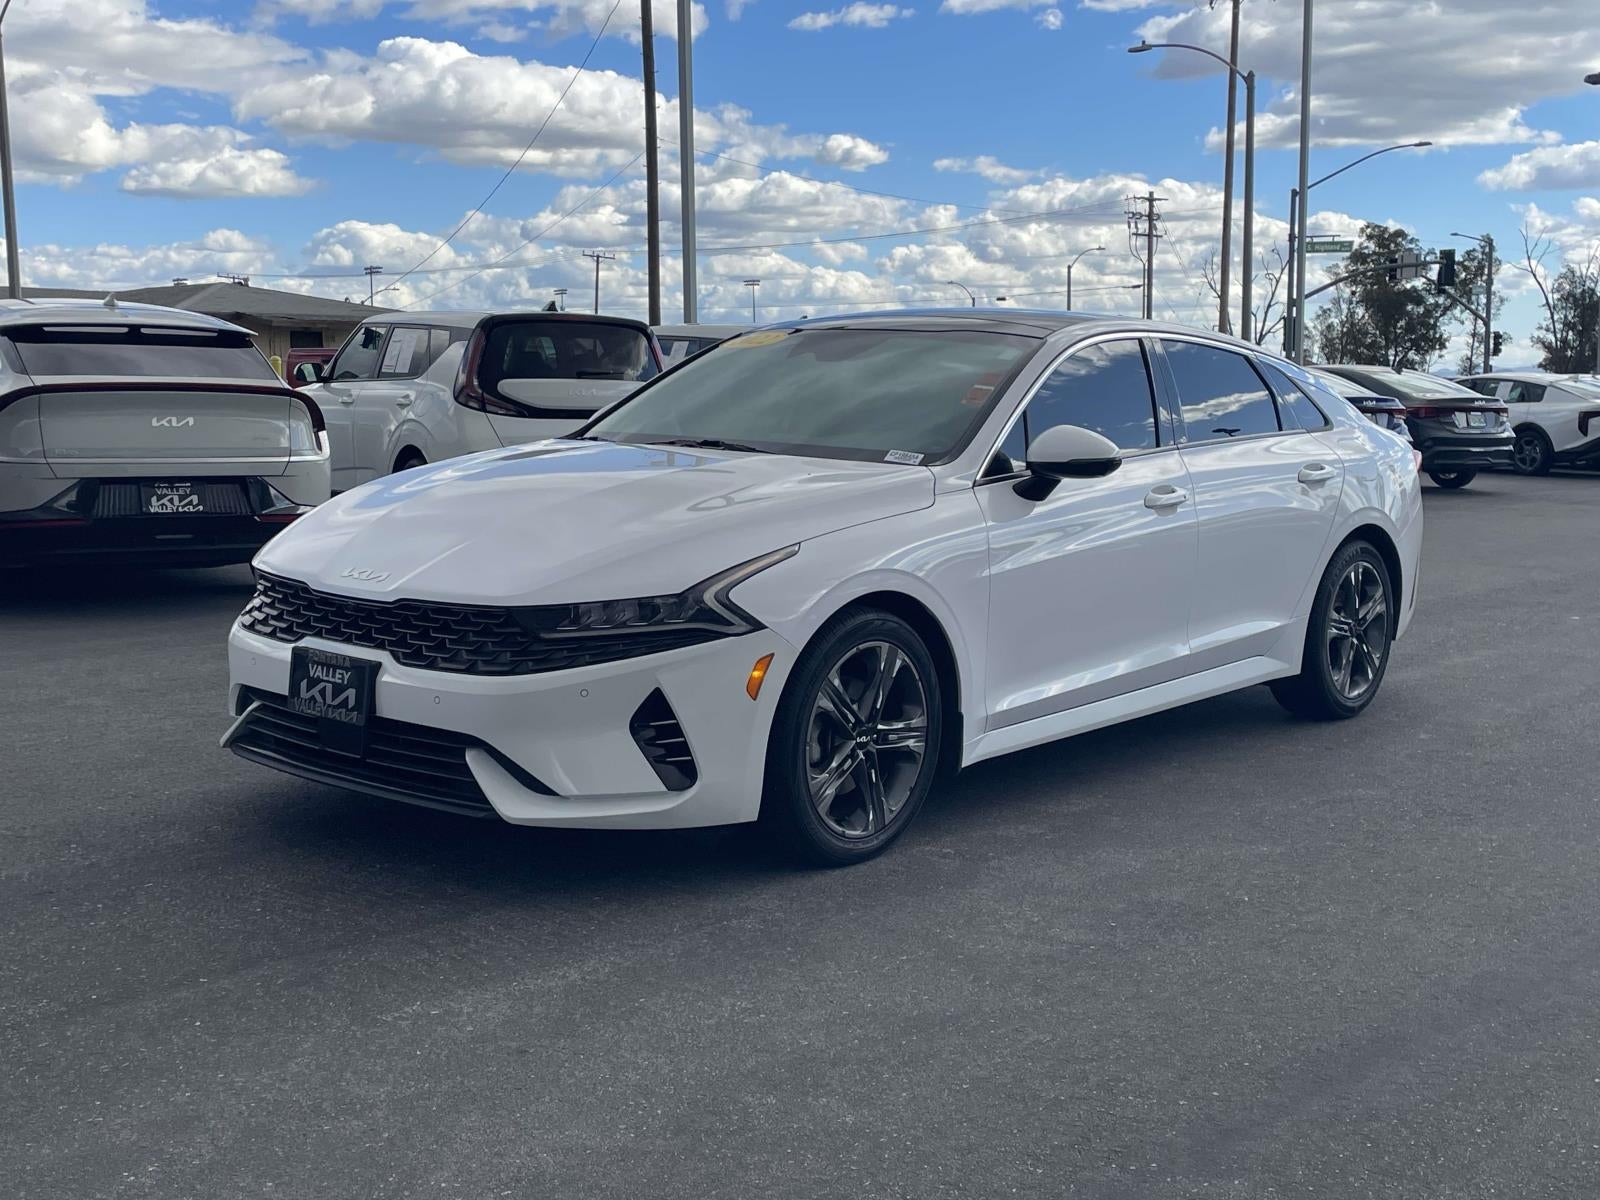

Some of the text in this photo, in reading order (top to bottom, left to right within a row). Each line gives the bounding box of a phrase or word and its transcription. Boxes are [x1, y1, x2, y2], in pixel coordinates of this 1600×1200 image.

[151, 416, 194, 427] KIA
[155, 487, 191, 495] VALLEY
[151, 494, 199, 506] KIA
[149, 505, 178, 513] VALLEY
[340, 566, 393, 583] KIA
[308, 663, 352, 685] VALLEY
[300, 678, 356, 709] KIA
[294, 697, 358, 723] VALLEY KIA
[856, 735, 871, 743] KIA
